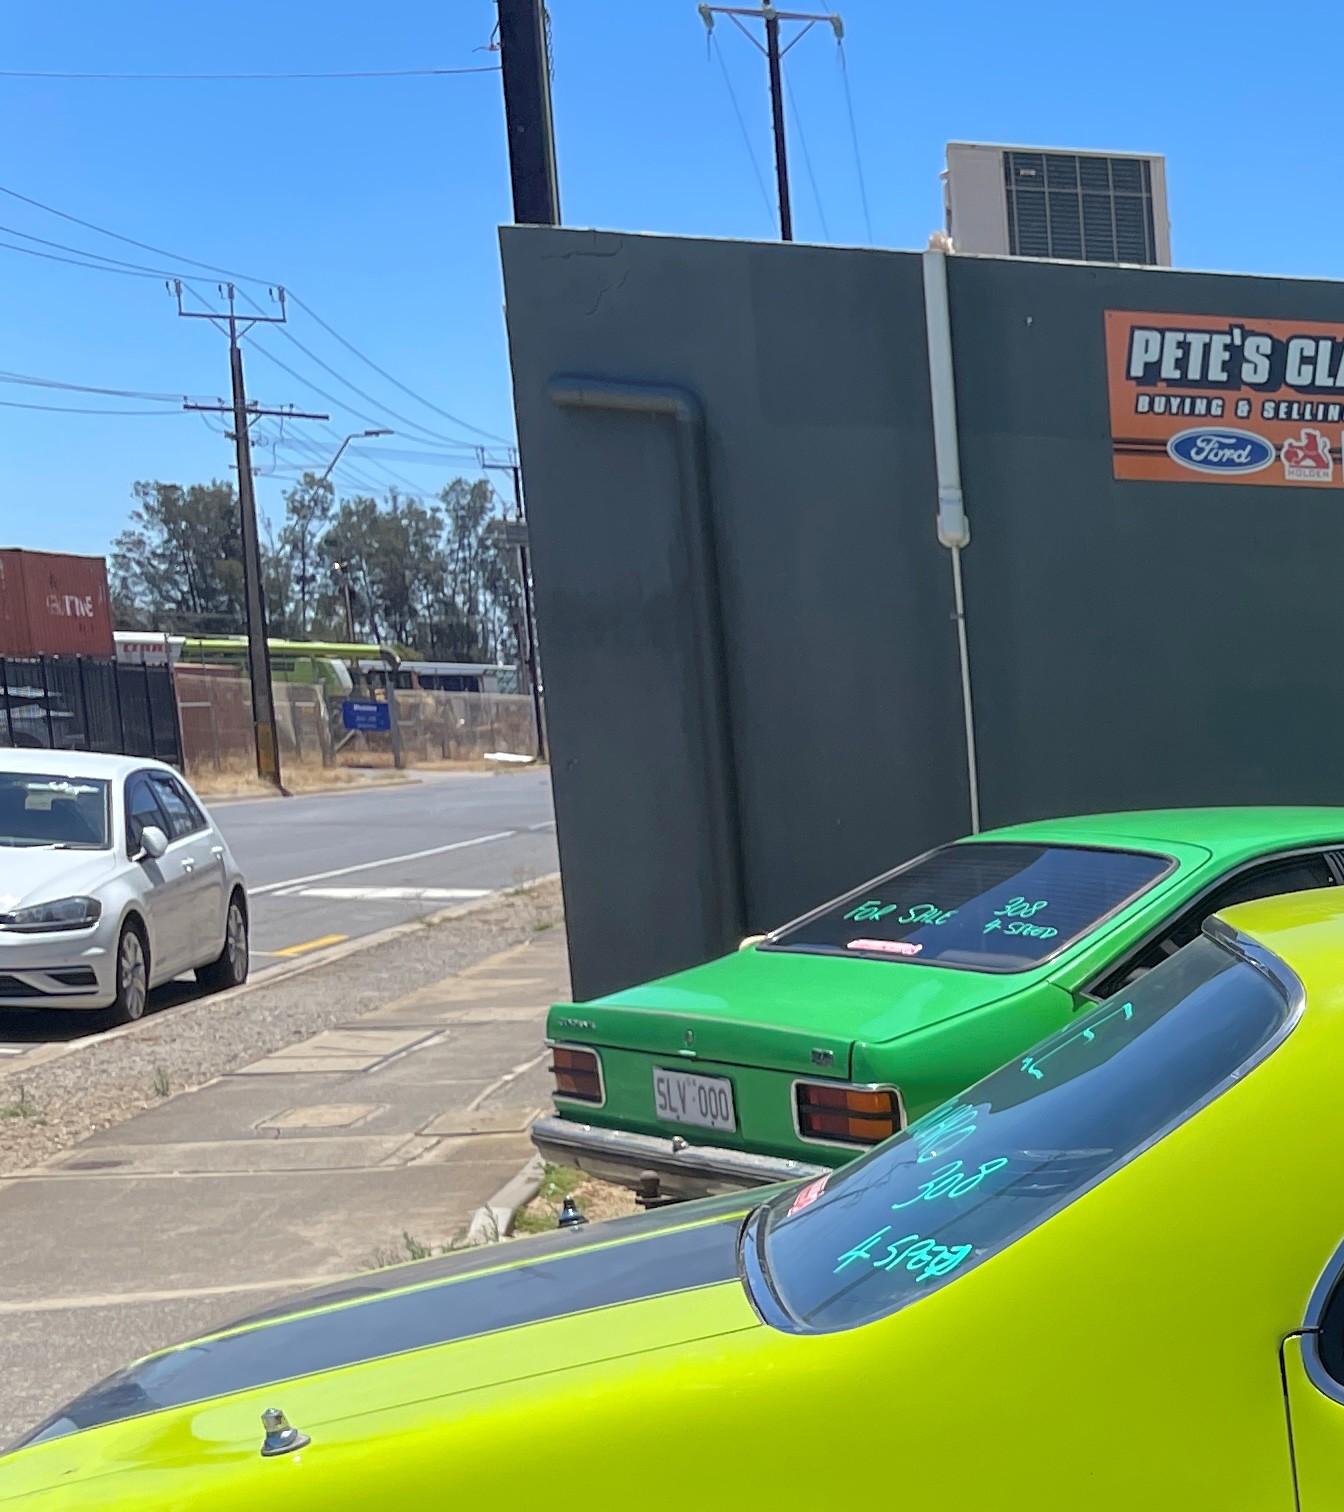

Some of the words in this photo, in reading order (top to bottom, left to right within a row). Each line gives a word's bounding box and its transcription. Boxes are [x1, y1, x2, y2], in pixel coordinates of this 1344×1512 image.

[1129, 326, 1272, 385] PETE'S
[1136, 394, 1224, 418] BUYING
[1236, 399, 1251, 418] &
[1190, 434, 1252, 464] Ford
[1287, 468, 1331, 479] HOLDEN
[843, 899, 897, 922] FOR
[898, 904, 959, 926] SALE
[993, 896, 1048, 919] 308
[1003, 921, 1059, 939] SPEED
[657, 1077, 687, 1115] SLY
[892, 1156, 1008, 1210] 308
